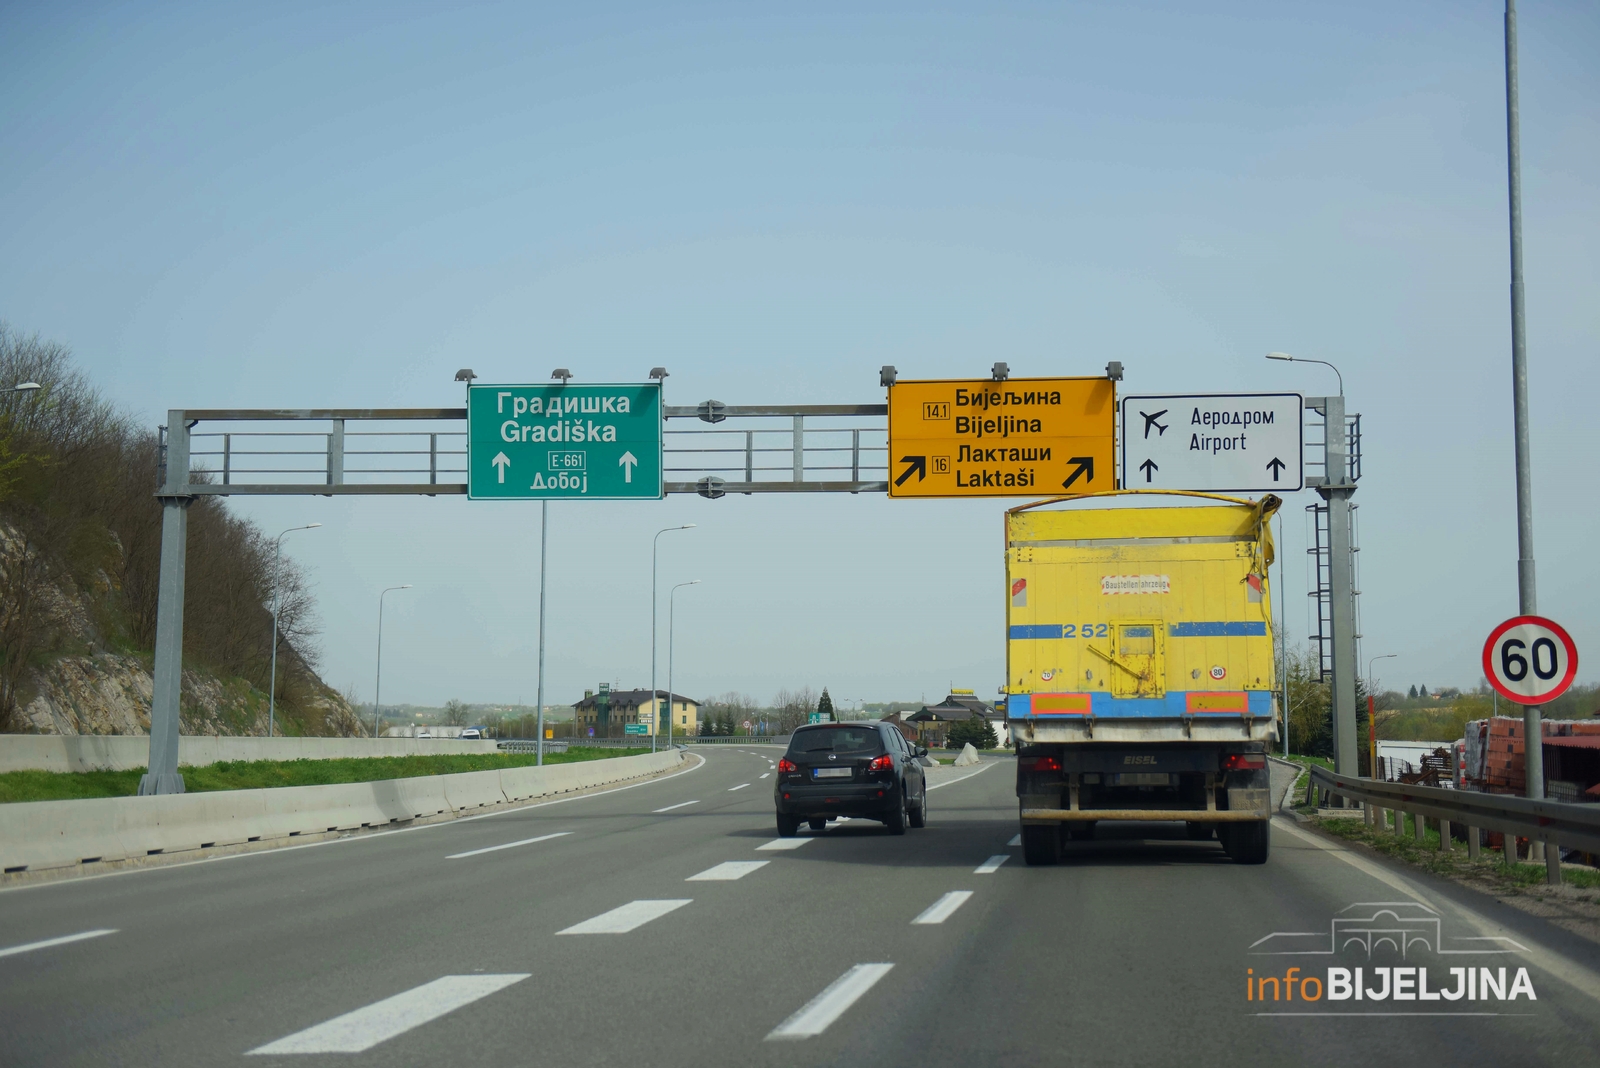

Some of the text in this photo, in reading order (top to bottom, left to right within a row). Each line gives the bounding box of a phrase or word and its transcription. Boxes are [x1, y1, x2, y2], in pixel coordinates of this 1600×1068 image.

[498, 392, 630, 418] Градишка
[956, 388, 1061, 410] Бијељина
[926, 404, 947, 418] 14.1
[1191, 407, 1274, 429] Аеродром
[500, 419, 617, 442] Gradiška
[956, 415, 1042, 438] Bijeljina
[956, 445, 1051, 463] Лакташи
[1189, 432, 1247, 455] Airport
[552, 454, 582, 467] E-661
[935, 458, 947, 471] 16
[530, 472, 588, 493] Добој
[956, 468, 1035, 488] Laktaši
[1501, 637, 1558, 682] 60
[1213, 668, 1223, 676] 80
[1123, 755, 1158, 765] EISEL
